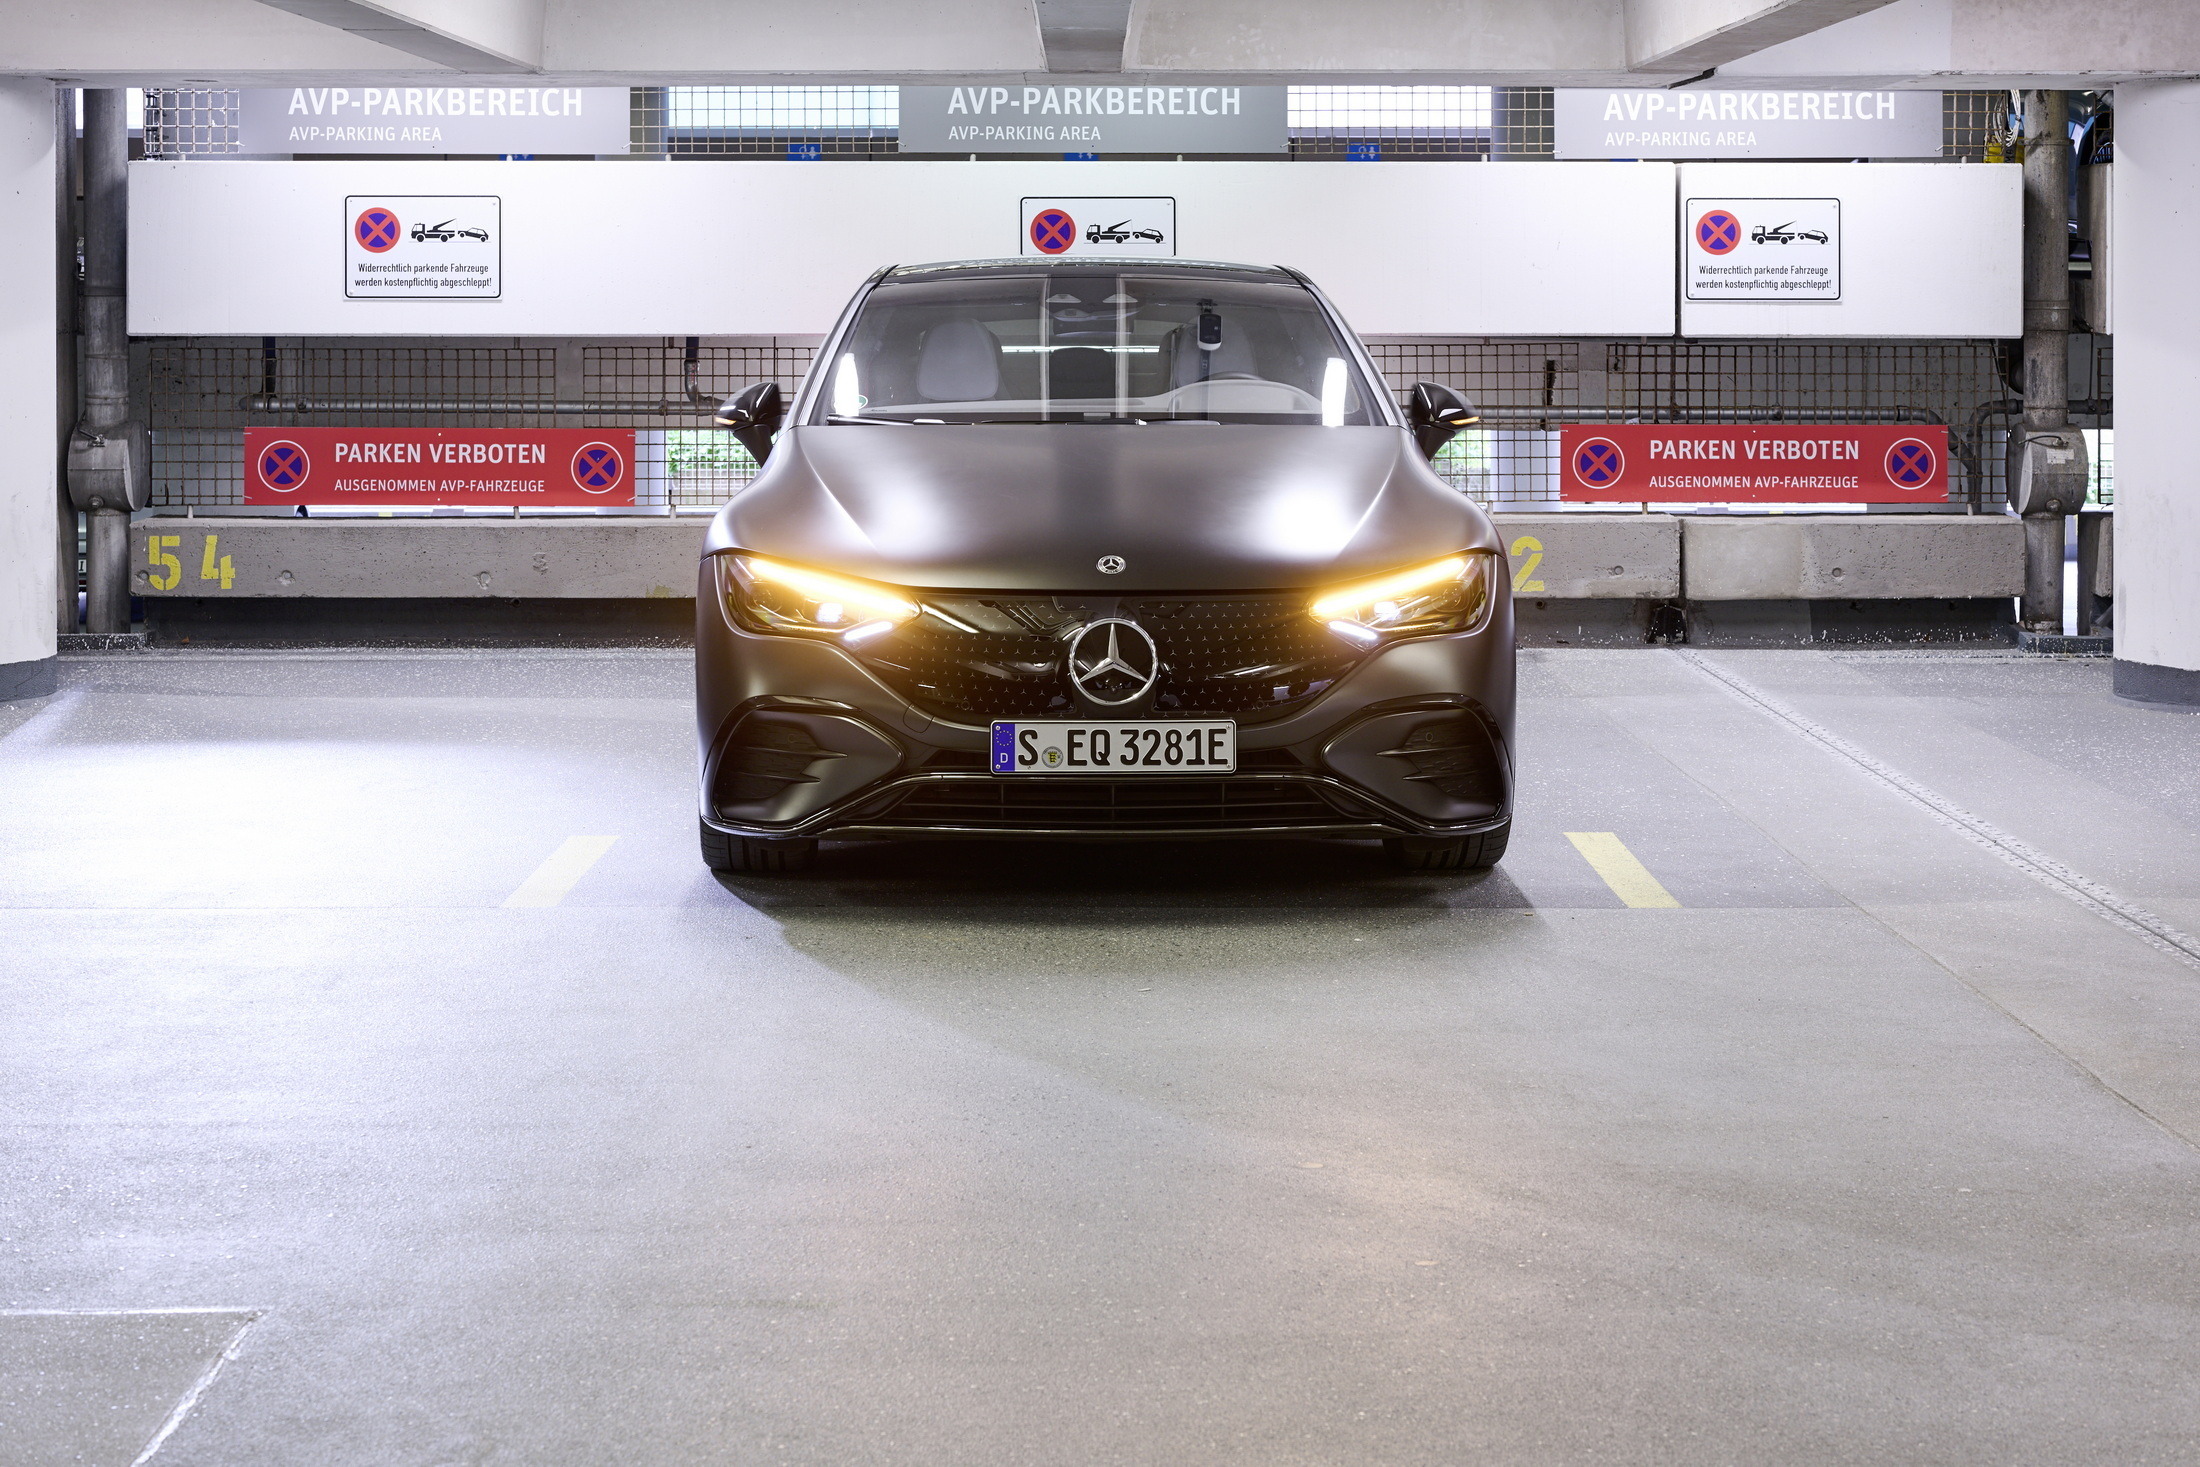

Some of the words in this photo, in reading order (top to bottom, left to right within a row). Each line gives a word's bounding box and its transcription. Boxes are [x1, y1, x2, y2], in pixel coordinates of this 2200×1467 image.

[288, 87, 583, 116] AVP-PARKBEREICH
[947, 87, 1241, 115] AVP-PARKBEREICH
[1603, 92, 1896, 121] AVP-PARKBEREICH
[289, 126, 396, 142] AVP-PARKING
[400, 127, 442, 142] AREA
[948, 126, 1055, 141] AVP-PARKING
[1060, 126, 1101, 141] AREA
[1604, 131, 1711, 147] AVP-PARKING
[1715, 131, 1757, 146] AREA
[358, 263, 412, 273] Widerrechtlich
[413, 263, 448, 275] parkende
[450, 263, 489, 275] Fahrzeuge
[1699, 265, 1752, 275] Widerrechtlich
[1754, 265, 1789, 277] parkende
[1790, 265, 1829, 277] Fahrzeuge
[354, 277, 383, 287] werden
[384, 277, 439, 289] kostenpflichtig
[440, 277, 492, 289] abgeschleppt!
[1695, 279, 1723, 289] werden
[1724, 279, 1779, 291] kostenpflichtig
[1780, 279, 1832, 291] abgeschleppt!
[335, 443, 422, 464] PARKEN
[429, 444, 546, 464] VERBOTEN
[1650, 440, 1736, 460] PARKEN
[1743, 440, 1859, 460] VERBOTEN
[334, 479, 436, 492] AUSGENOMMEN
[440, 480, 545, 493] AVP-FAHRZEUGE
[1649, 476, 1751, 488] AUSGENOMMEN
[1754, 475, 1859, 488] AVP-FAHRZEUGE
[1018, 730, 1039, 766] S
[1119, 729, 1229, 766] 3281E
[1000, 753, 1009, 764] D
